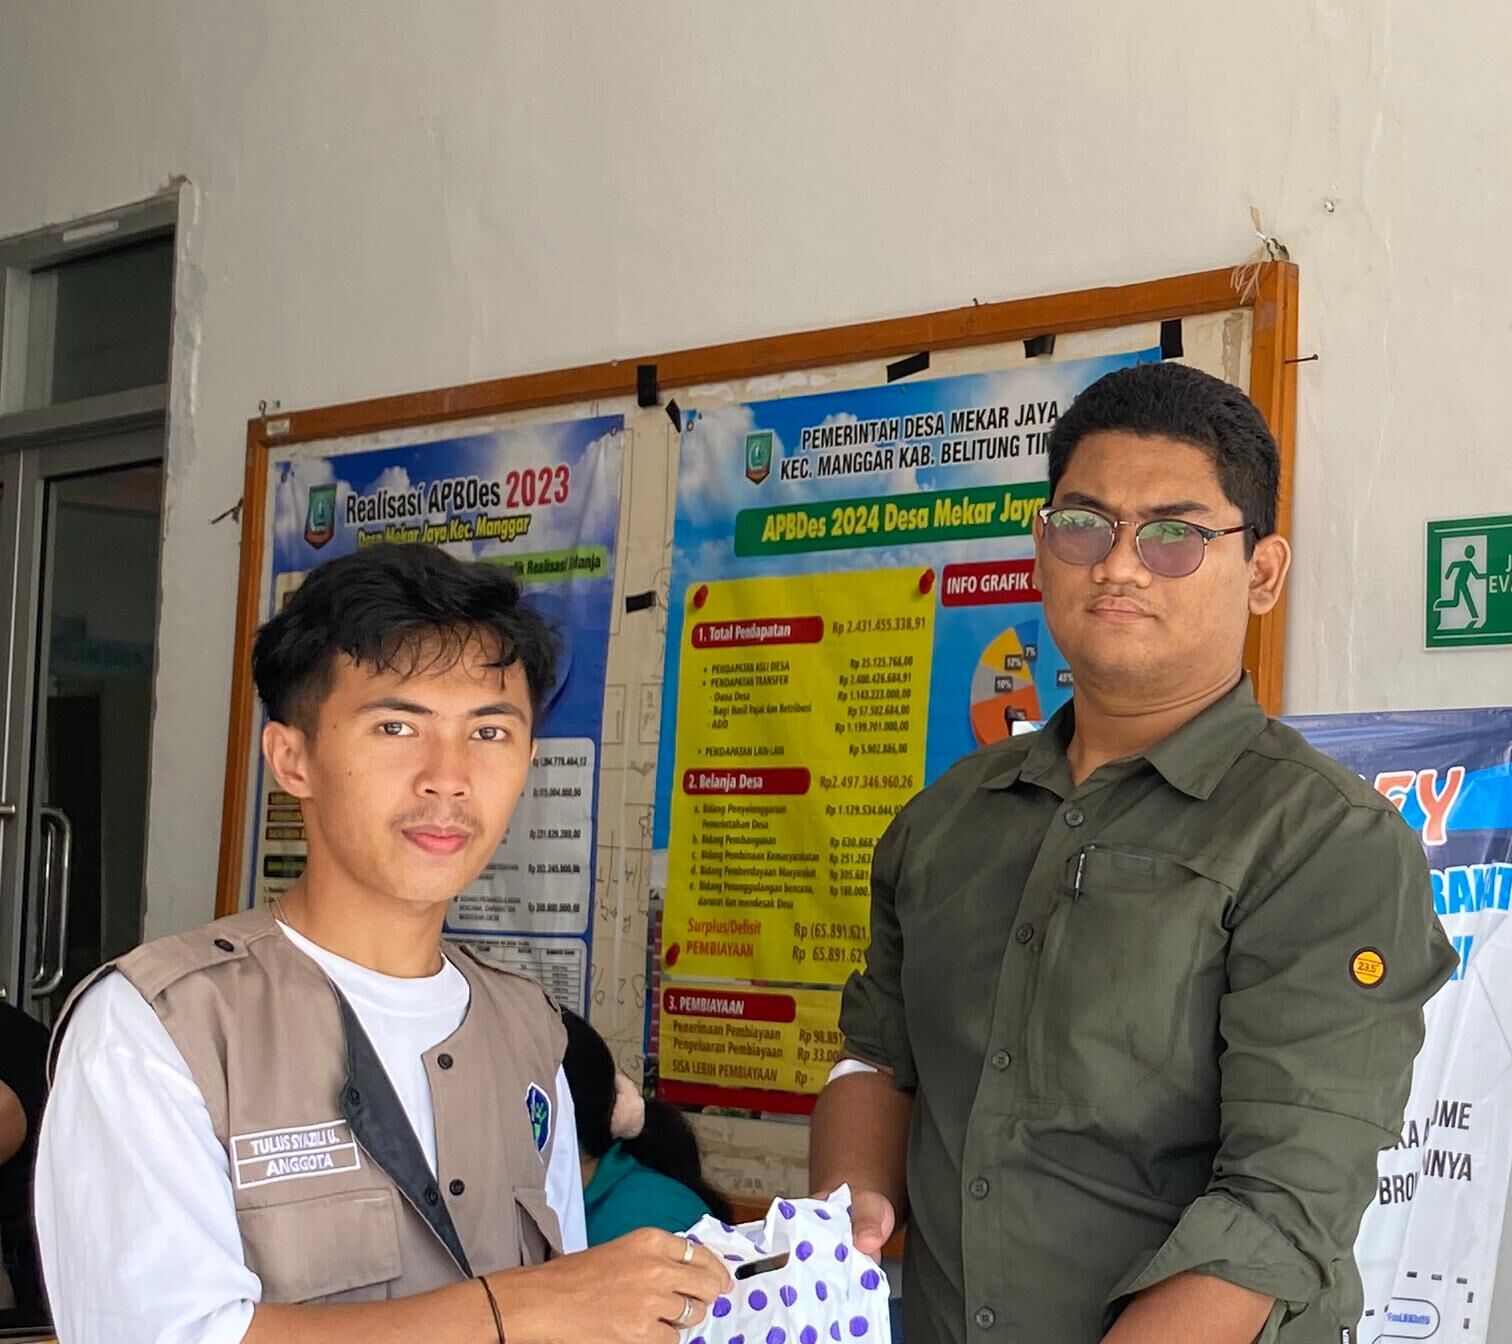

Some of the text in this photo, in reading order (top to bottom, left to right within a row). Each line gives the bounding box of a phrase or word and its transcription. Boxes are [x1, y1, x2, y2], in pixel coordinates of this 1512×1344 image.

[802, 401, 1058, 450] PEMERINTAH DESA MEKAR JAYA
[781, 457, 813, 480] KEC.
[818, 450, 894, 477] MANGGAR
[899, 445, 935, 469] KAB.
[941, 437, 1020, 464] BELITUNG
[346, 465, 570, 524] Realisasi APBDes 2023
[761, 511, 826, 543] APBDes
[831, 504, 879, 537] 2024
[885, 503, 929, 531] Desa
[934, 496, 995, 527] Mekar
[421, 522, 448, 544] Jaya
[450, 518, 473, 539] Kec.
[476, 515, 531, 542] Manggar
[947, 572, 1029, 594] INFO GRAFIK
[709, 625, 733, 641] Total
[735, 623, 791, 641] Pendapatan
[832, 621, 844, 636] Rp
[755, 675, 789, 686] TRANSFER
[688, 773, 763, 792] 2. Belanja Desa
[794, 922, 807, 940] Rp
[686, 941, 754, 957] PEMBIAYAAN
[792, 946, 806, 964] Rp
[669, 996, 744, 1015] 3. PEMBIAYAAN
[673, 1020, 781, 1042] Penerimaan Pembiayaan
[800, 1029, 811, 1044] Rp
[673, 1037, 783, 1059] Pengeluaran Pembiayaan
[797, 1047, 810, 1063] Rp
[672, 1059, 778, 1082] SISA LEBIH PEMBIAYAAN
[795, 1070, 807, 1085] Rp
[250, 1135, 291, 1155] TULUS
[267, 1153, 334, 1177] ANGGOTA
